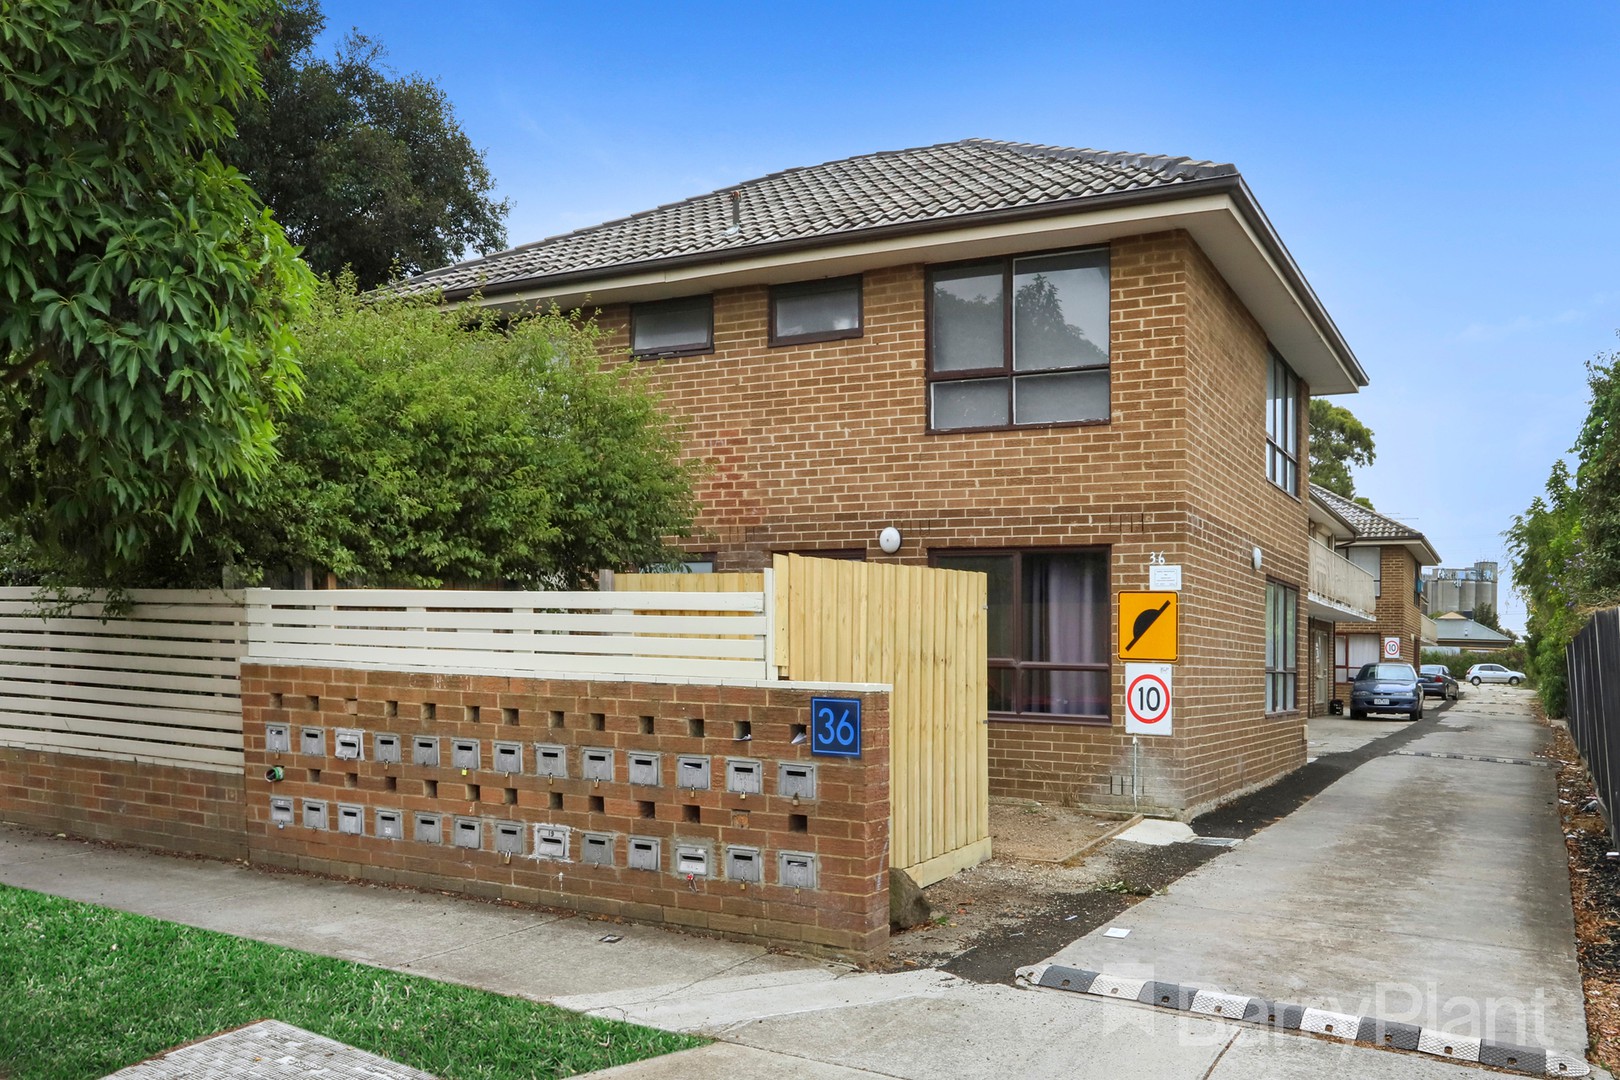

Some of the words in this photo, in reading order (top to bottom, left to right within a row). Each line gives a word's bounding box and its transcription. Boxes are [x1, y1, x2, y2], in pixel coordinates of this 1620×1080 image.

[1149, 551, 1166, 565] 36
[1388, 643, 1396, 652] 10
[1138, 686, 1161, 711] 10
[817, 707, 855, 746] 36
